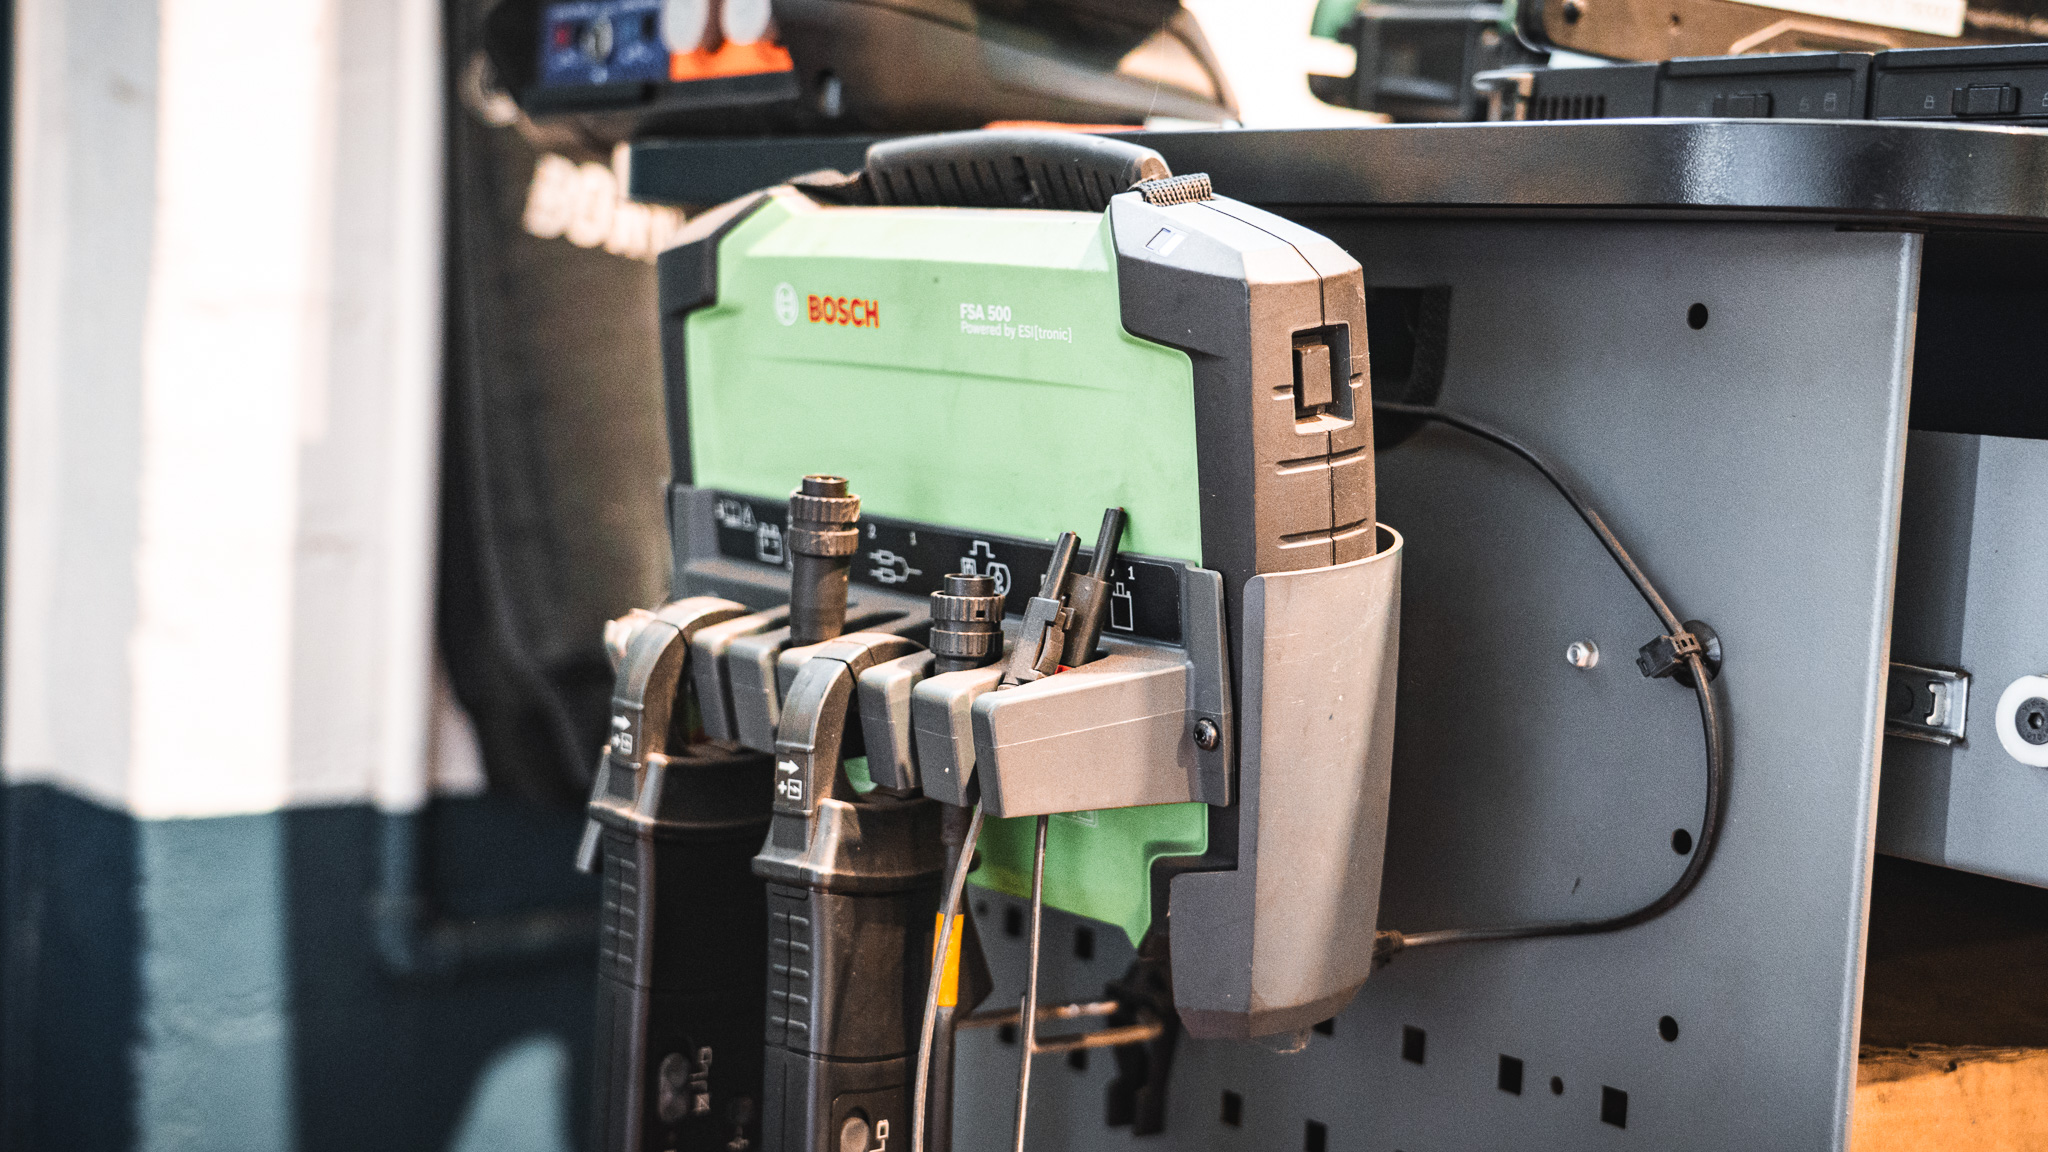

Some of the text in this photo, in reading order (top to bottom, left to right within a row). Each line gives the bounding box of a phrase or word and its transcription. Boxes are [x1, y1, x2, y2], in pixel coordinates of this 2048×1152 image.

[807, 294, 879, 328] BOSCH
[960, 303, 1012, 322] FSA 500
[960, 320, 1072, 343] Powered by ESI[tronic]
[1127, 565, 1135, 580] 1
